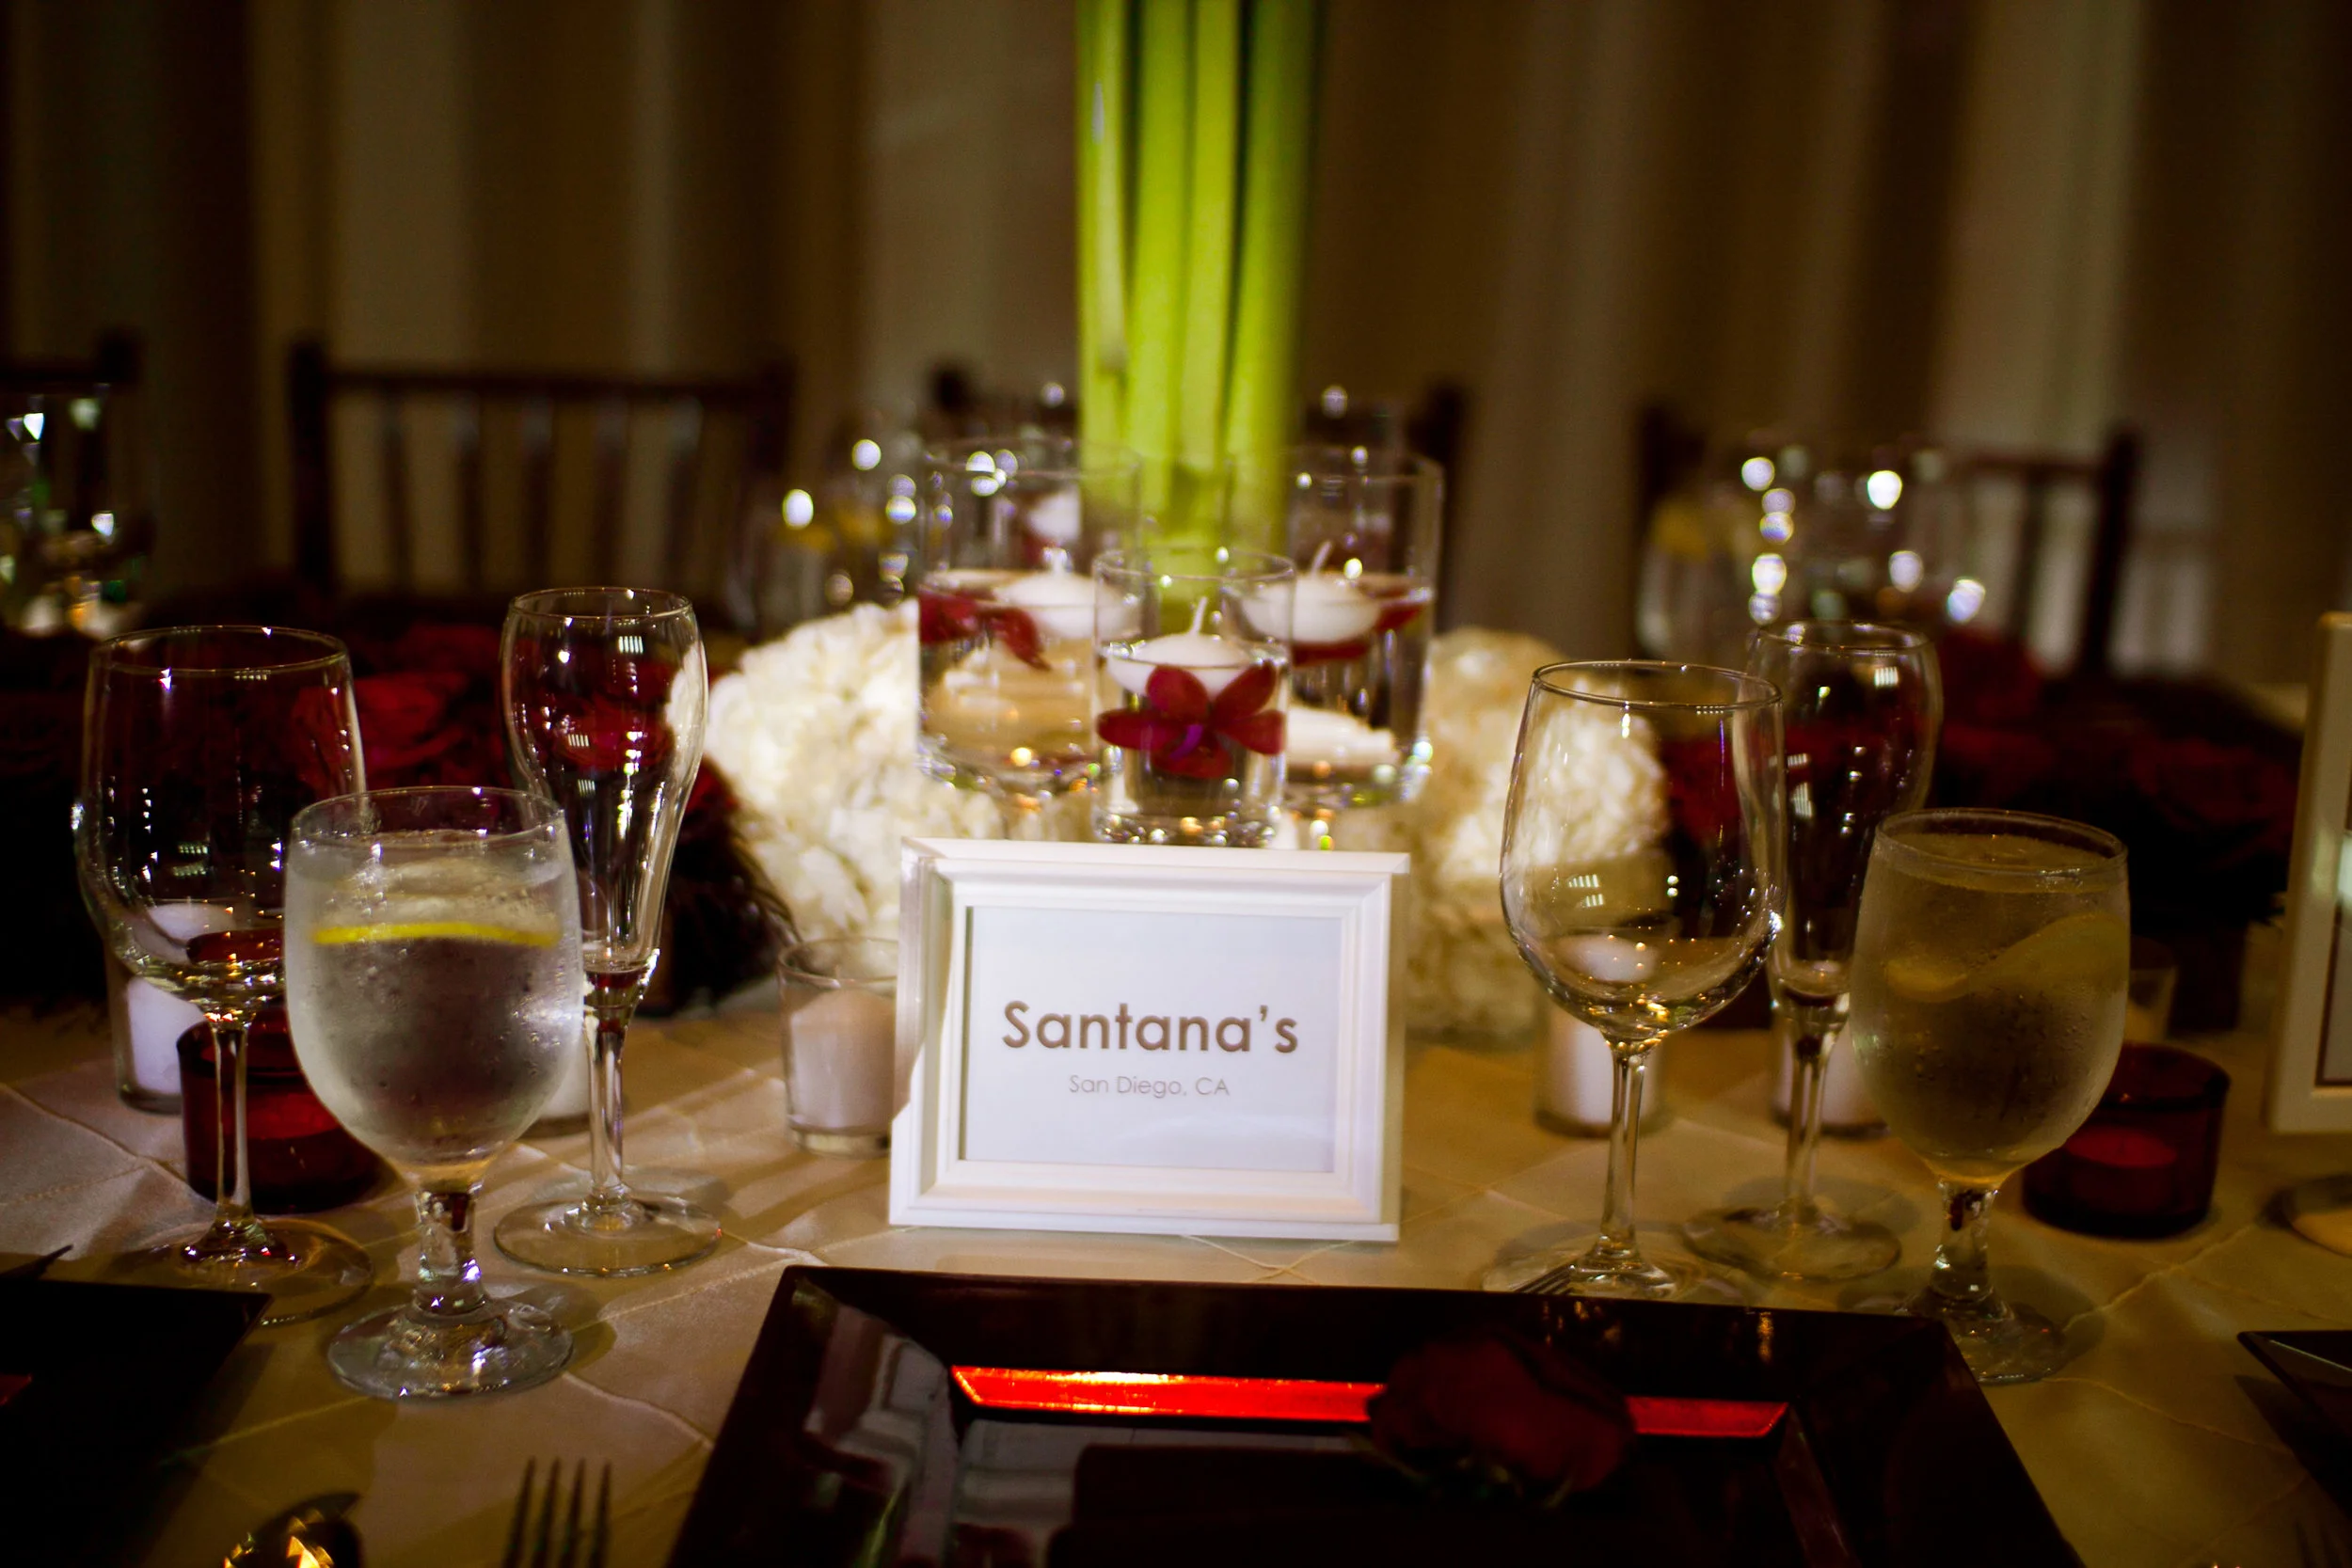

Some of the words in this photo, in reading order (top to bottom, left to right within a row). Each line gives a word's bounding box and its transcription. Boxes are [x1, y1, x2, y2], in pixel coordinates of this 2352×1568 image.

[1002, 1000, 1298, 1053] Santana's
[1069, 1074, 1109, 1095] San
[1117, 1075, 1187, 1099] Diego,
[1195, 1077, 1231, 1097] CA
